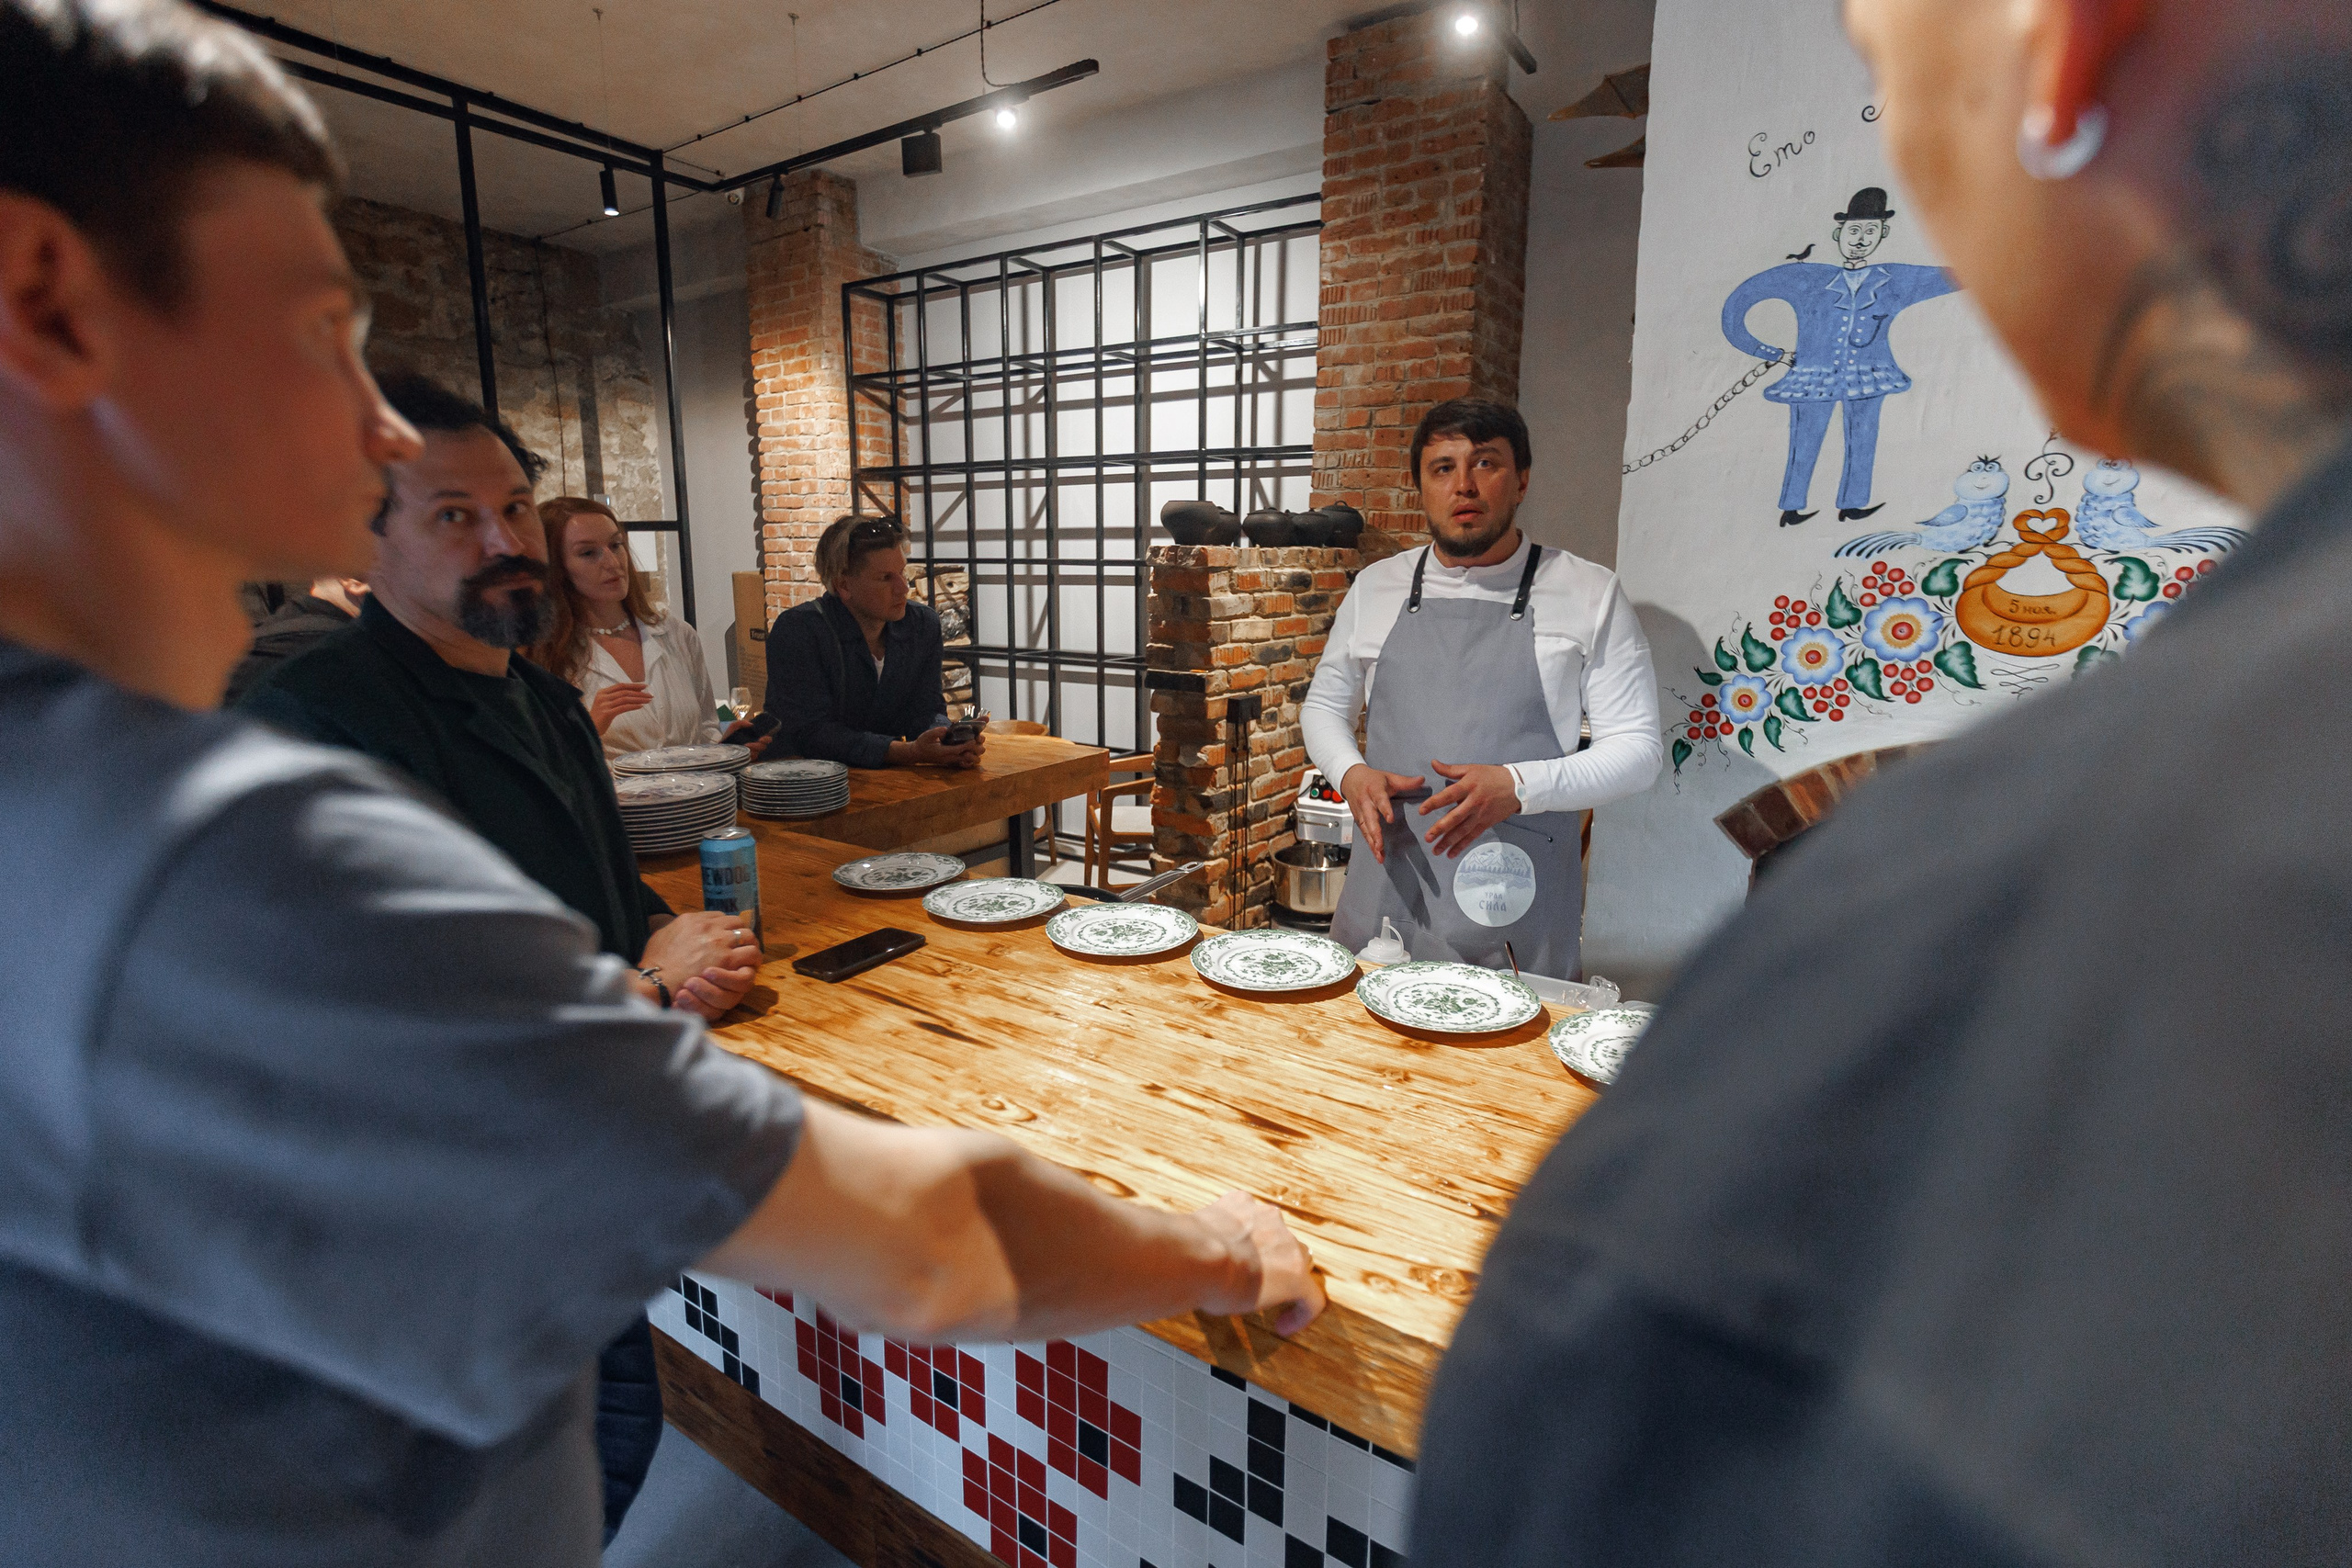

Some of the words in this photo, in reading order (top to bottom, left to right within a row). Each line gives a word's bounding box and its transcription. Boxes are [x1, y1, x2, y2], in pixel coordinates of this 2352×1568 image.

[2008, 598, 2020, 615] 5
[1991, 624, 2056, 649] 1894
[1478, 899, 1507, 912] СИЛА
